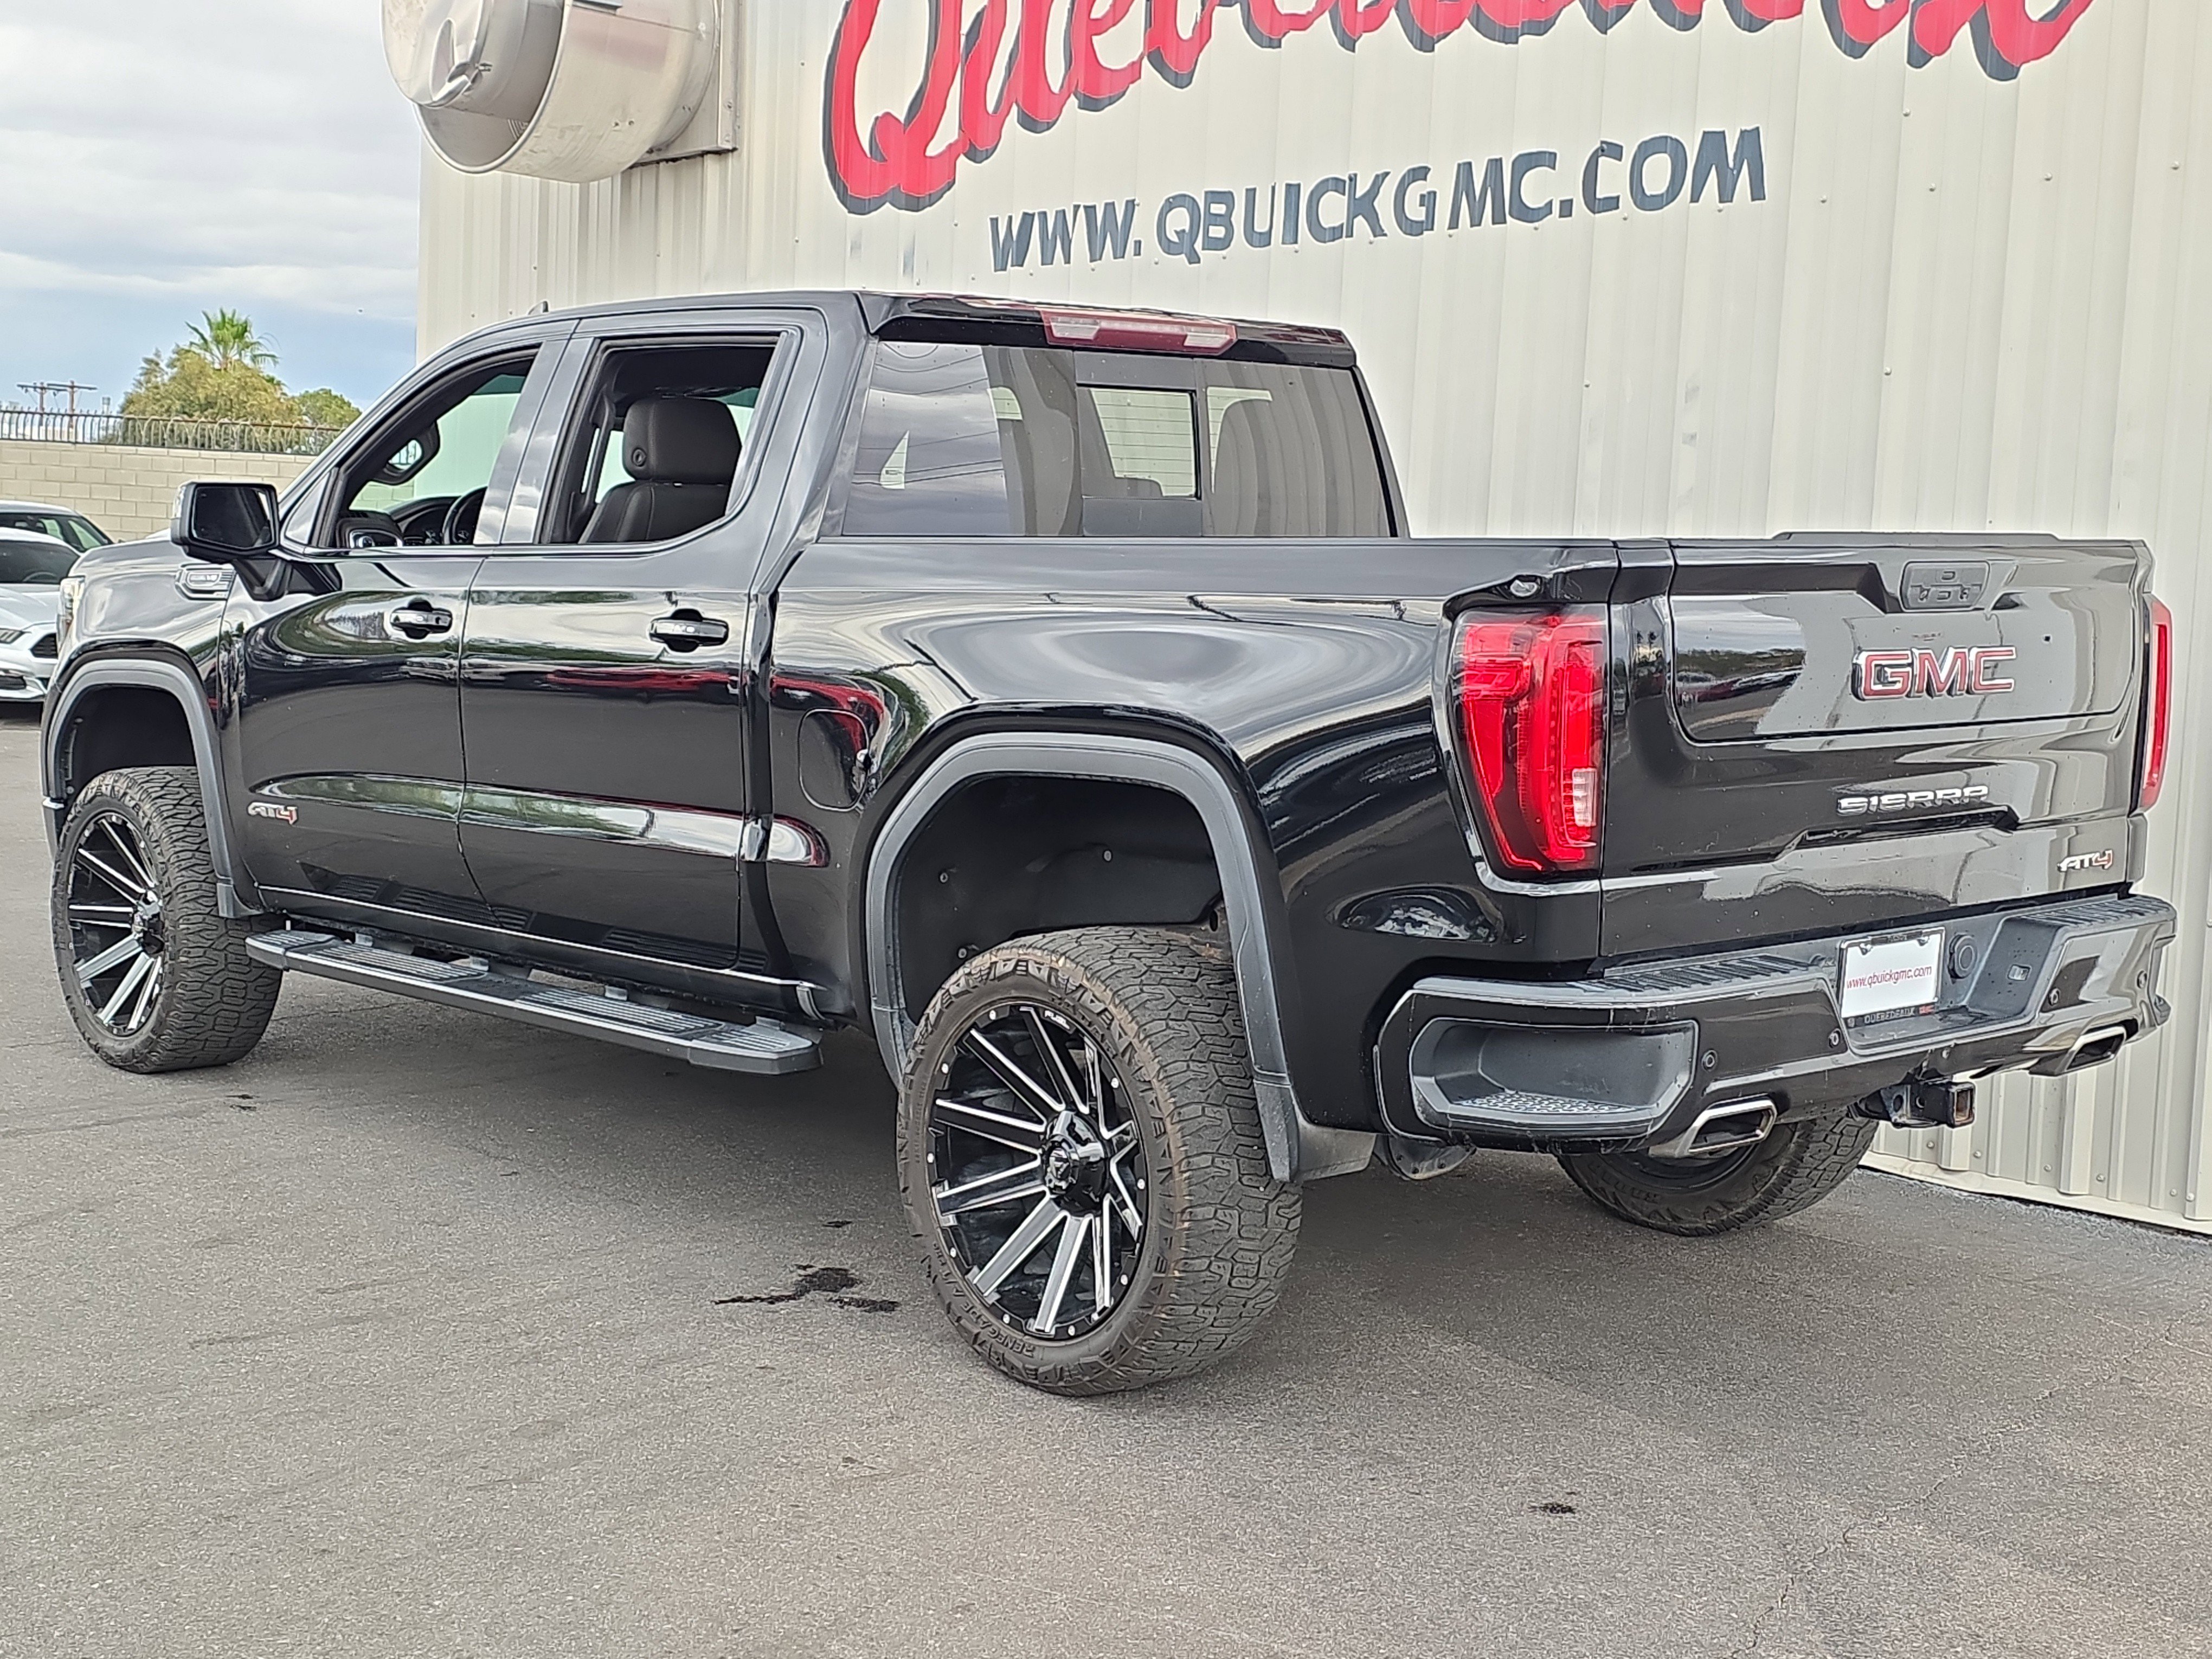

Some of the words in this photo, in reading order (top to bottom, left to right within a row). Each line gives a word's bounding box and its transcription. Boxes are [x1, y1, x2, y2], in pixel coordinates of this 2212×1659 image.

[1852, 645, 2016, 700] GMC
[1838, 786, 1989, 814] SIERRA
[248, 802, 298, 825] AT4
[2058, 849, 2113, 872] AT4
[1846, 966, 1932, 989] www.qbuickgmc.com
[960, 1302, 1036, 1358] RENEGADE
